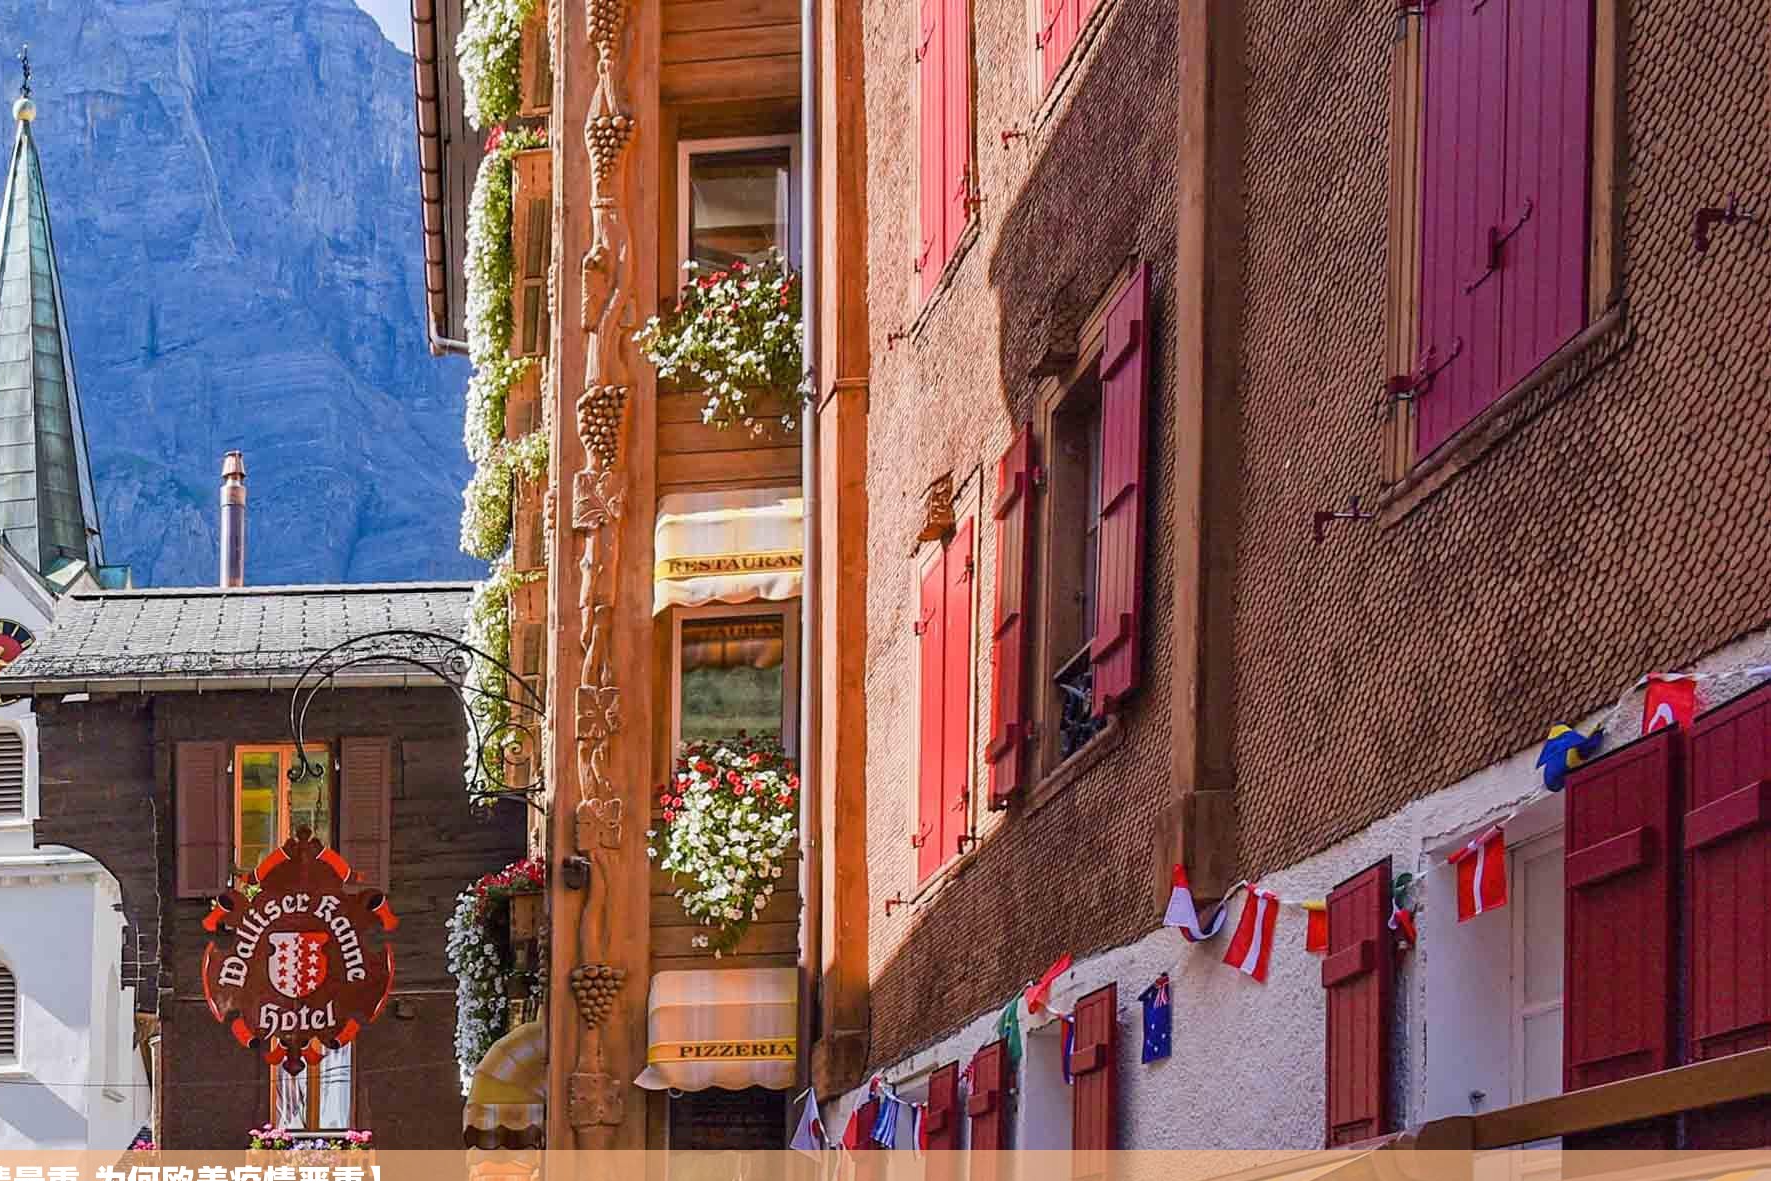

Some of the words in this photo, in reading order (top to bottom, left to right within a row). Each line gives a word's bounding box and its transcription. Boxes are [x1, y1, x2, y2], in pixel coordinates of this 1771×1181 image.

[668, 555, 804, 573] RESTAURAN
[218, 893, 310, 988] Walliser
[313, 895, 366, 983] Kanne
[259, 1000, 337, 1041] Hotel
[678, 1043, 794, 1058] PIZZERIA
